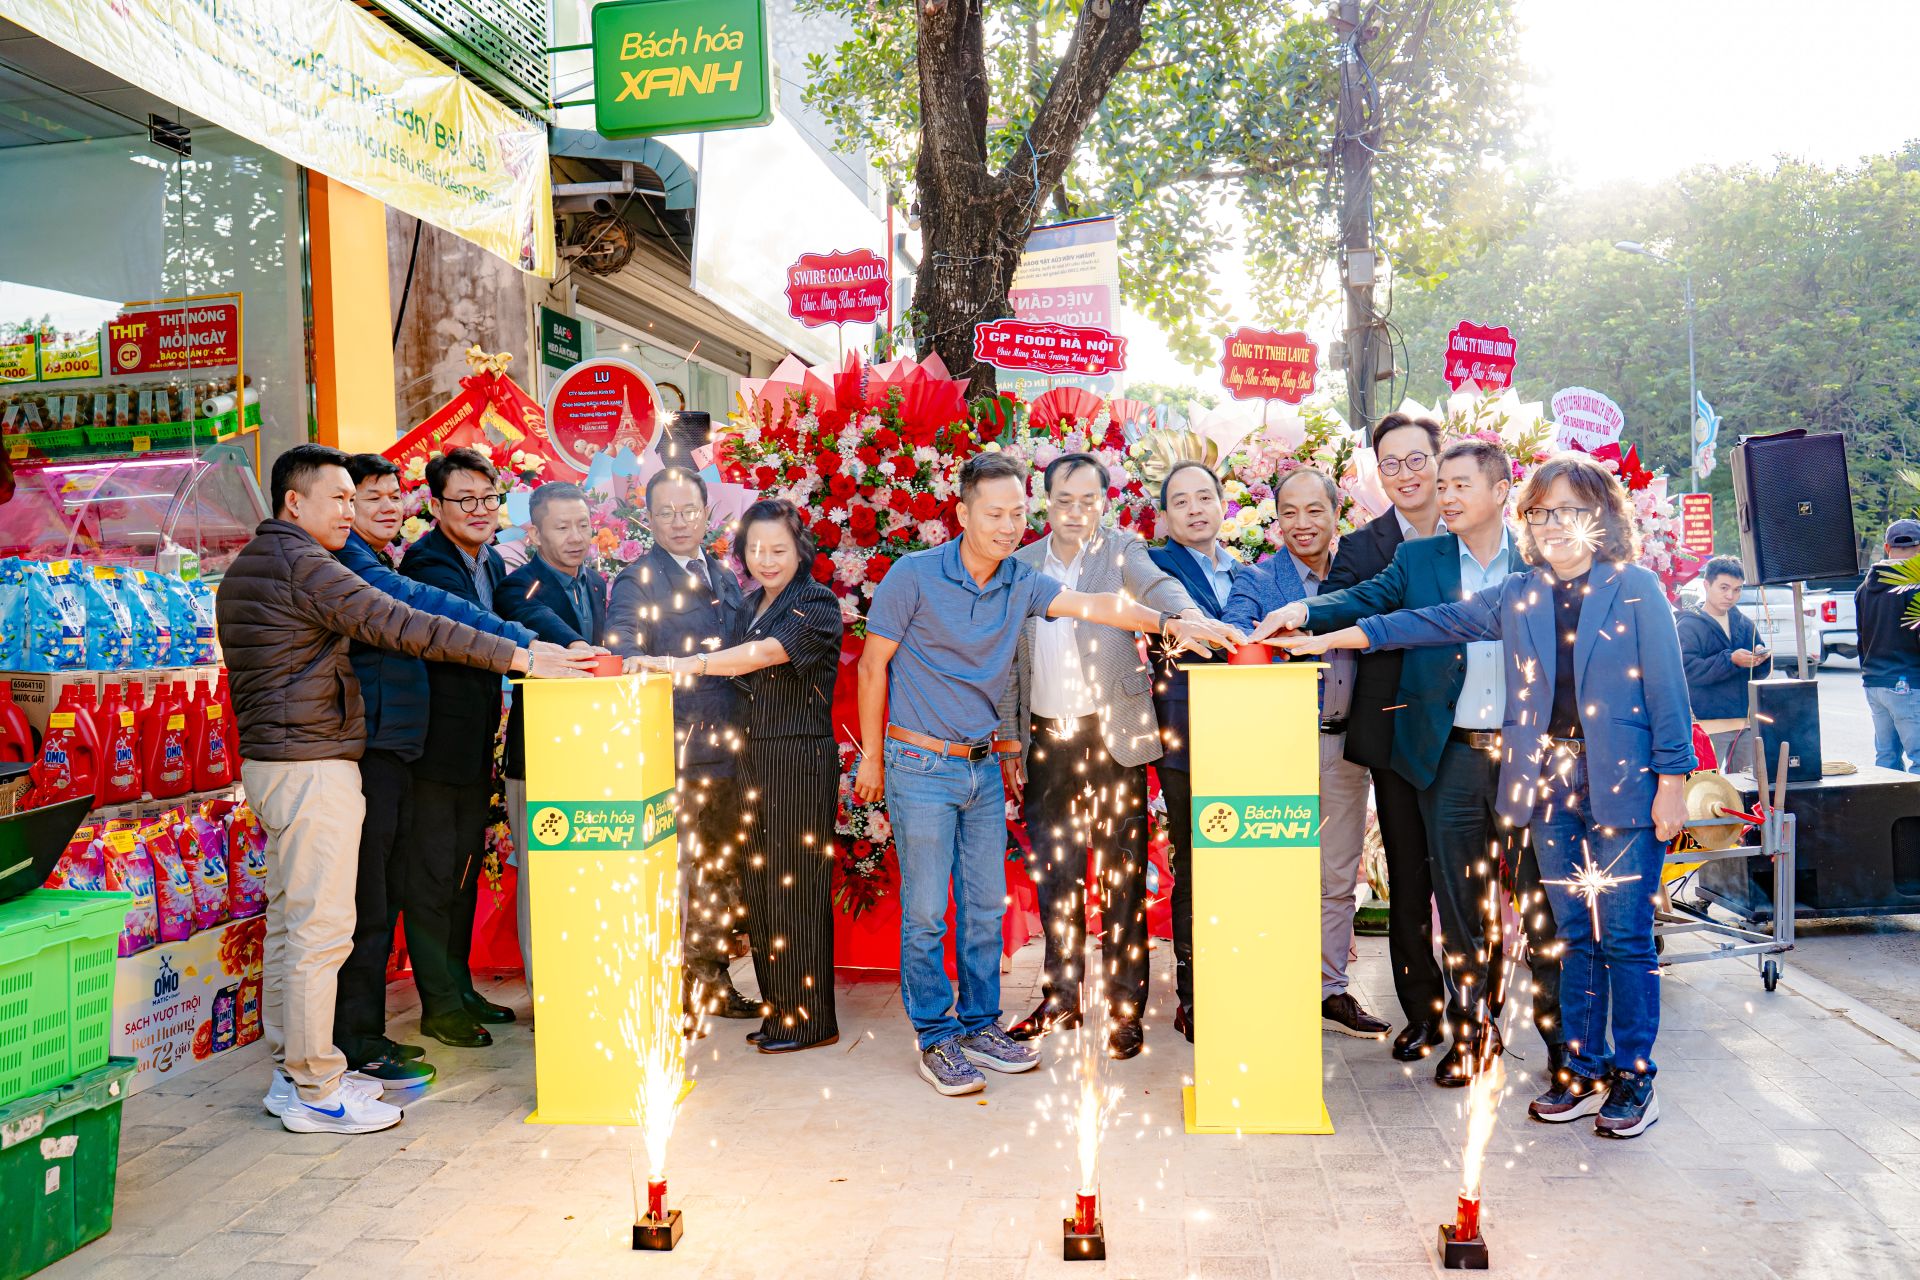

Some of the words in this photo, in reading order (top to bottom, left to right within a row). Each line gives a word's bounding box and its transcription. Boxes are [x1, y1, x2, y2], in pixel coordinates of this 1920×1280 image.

[619, 28, 688, 61] Bách
[693, 23, 744, 54] hóa
[614, 60, 743, 103] XANH
[794, 269, 826, 286] SWIRE
[828, 264, 884, 283] COCA-COLA
[159, 312, 188, 329] THỊT
[187, 308, 226, 324] NÓNG
[109, 323, 146, 341] THỊT
[188, 328, 227, 347] NGÀY
[553, 323, 567, 337] BAF
[989, 332, 1010, 343] CP
[1015, 334, 1056, 347] FOOD
[1060, 337, 1082, 350] HÀ
[1086, 340, 1114, 353] NỘI
[1452, 332, 1468, 352] CÔNG
[1469, 338, 1477, 353] TY
[1477, 339, 1494, 355] TNHH
[121, 350, 138, 362] CP
[1232, 340, 1253, 359] CÔNG
[1254, 344, 1265, 360] TY
[1265, 345, 1287, 362] TNHH
[1288, 347, 1310, 363] LAVIE
[594, 371, 610, 383] LU
[13, 681, 42, 690] 65064110
[45, 751, 66, 763] OMO
[117, 749, 132, 761] OMO
[166, 745, 181, 758] OMO
[574, 810, 608, 824] Bách
[609, 810, 635, 824] hóa
[1244, 805, 1281, 820] Bách
[1283, 805, 1312, 819] hóa
[570, 826, 634, 843] XANH
[1240, 822, 1311, 839] XANH
[154, 972, 179, 997] OMO
[152, 997, 169, 1006] MATIC
[243, 998, 257, 1013] OMO
[124, 1015, 151, 1036] SẠCH
[152, 1003, 179, 1024] VƯỢT
[181, 995, 201, 1014] TRỘI
[219, 1008, 233, 1023] OMO
[152, 1041, 174, 1073] 72
